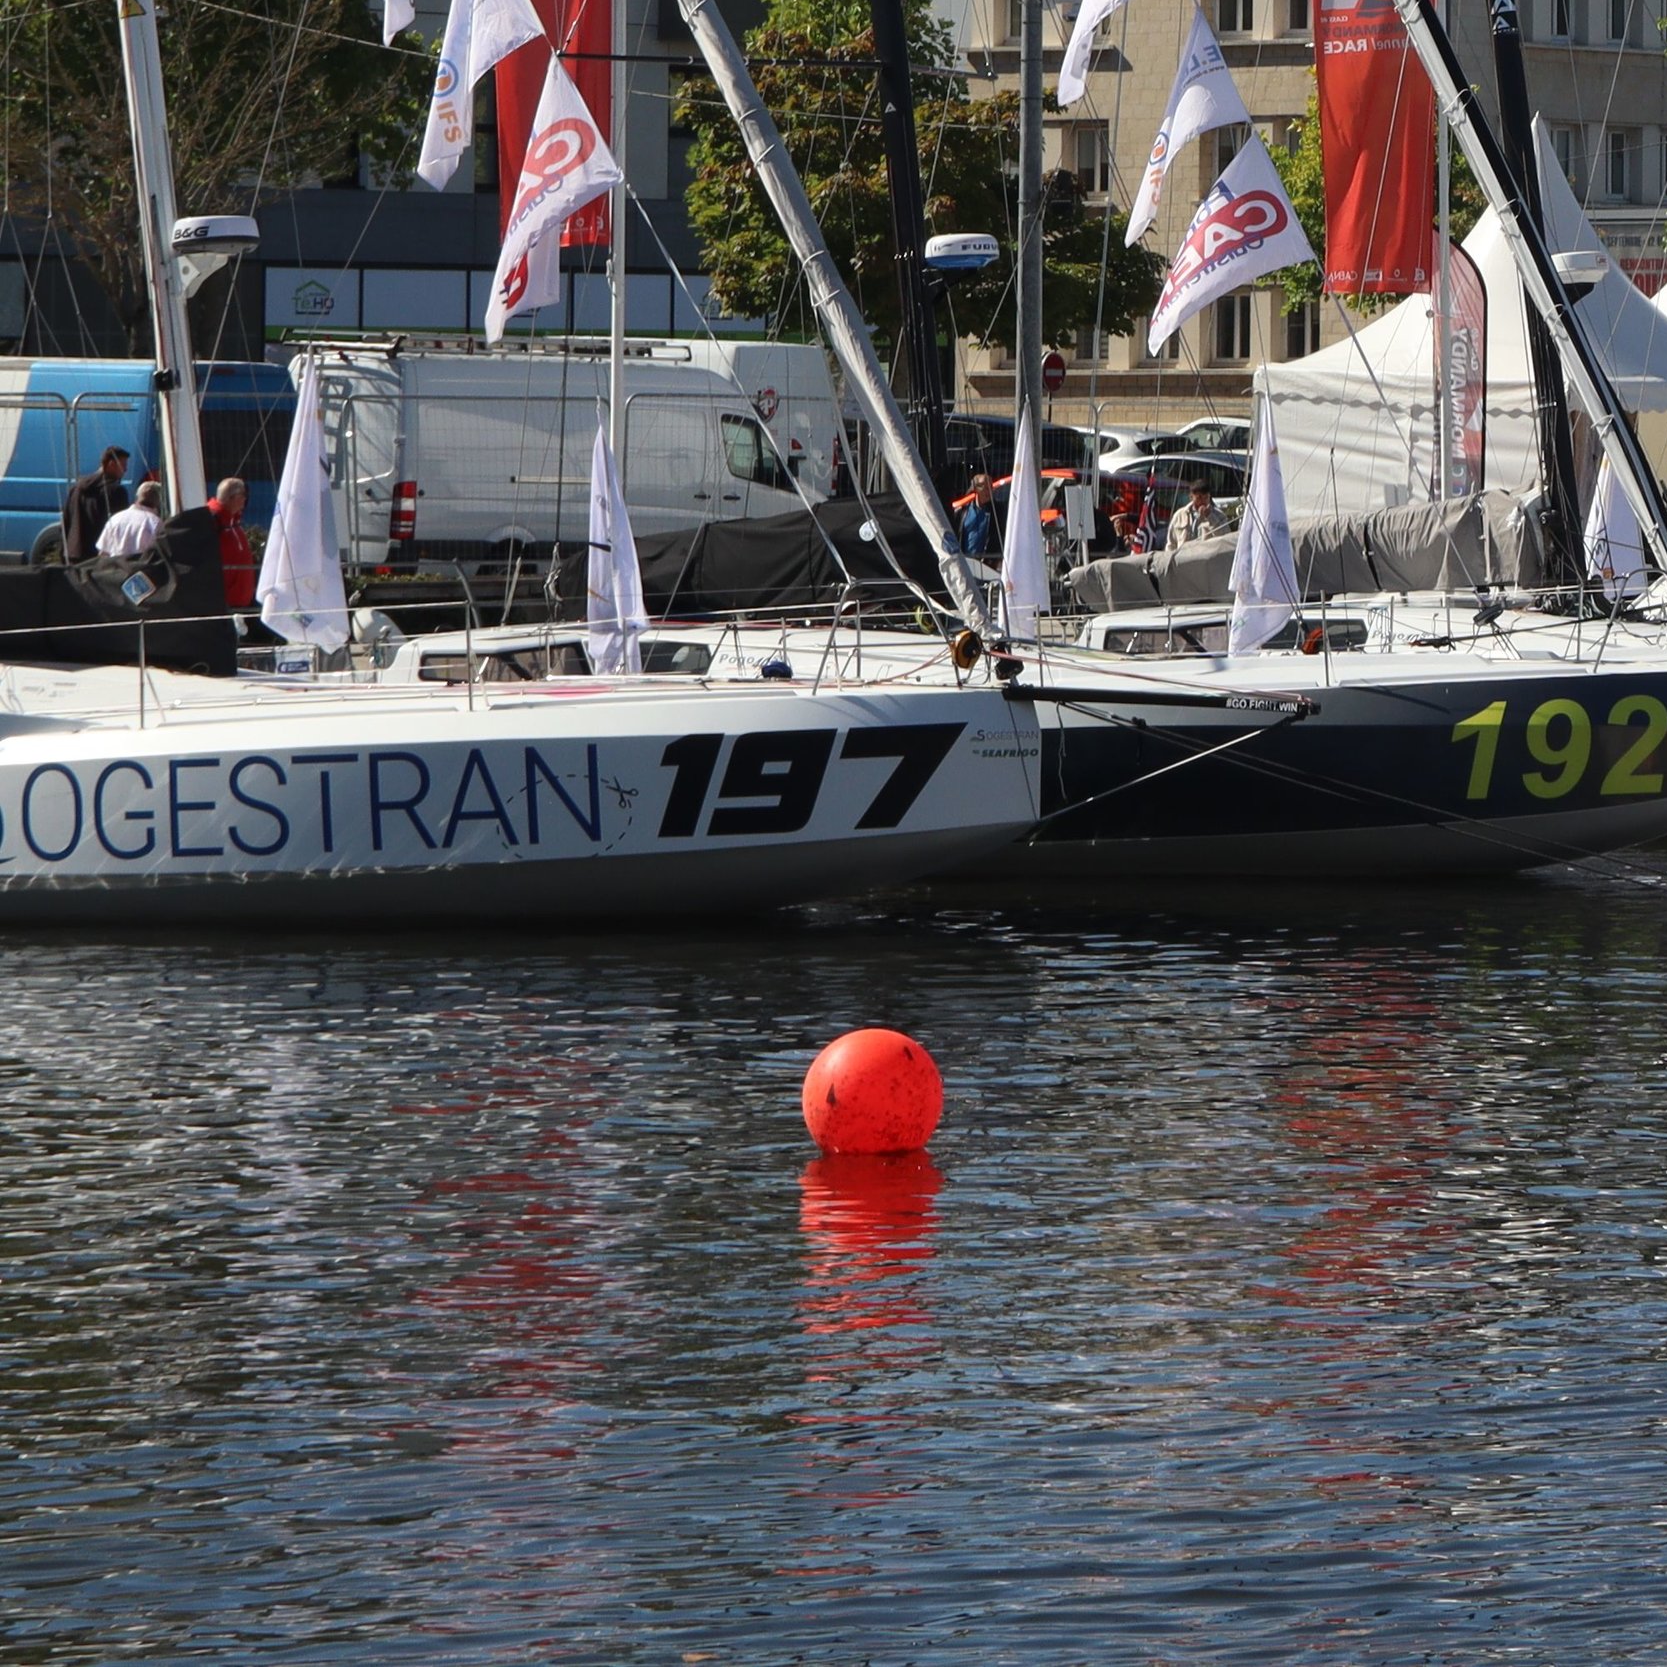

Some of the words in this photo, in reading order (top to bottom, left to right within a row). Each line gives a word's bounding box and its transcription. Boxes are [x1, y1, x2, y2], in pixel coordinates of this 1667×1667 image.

[174, 226, 210, 241] B&G
[961, 242, 998, 252] FURU
[1226, 697, 1247, 710] #GO
[1279, 701, 1298, 713] WIN
[982, 747, 1039, 759] SEAFRIGO
[658, 721, 968, 838] 197
[0, 744, 600, 865] OGESTRAN
